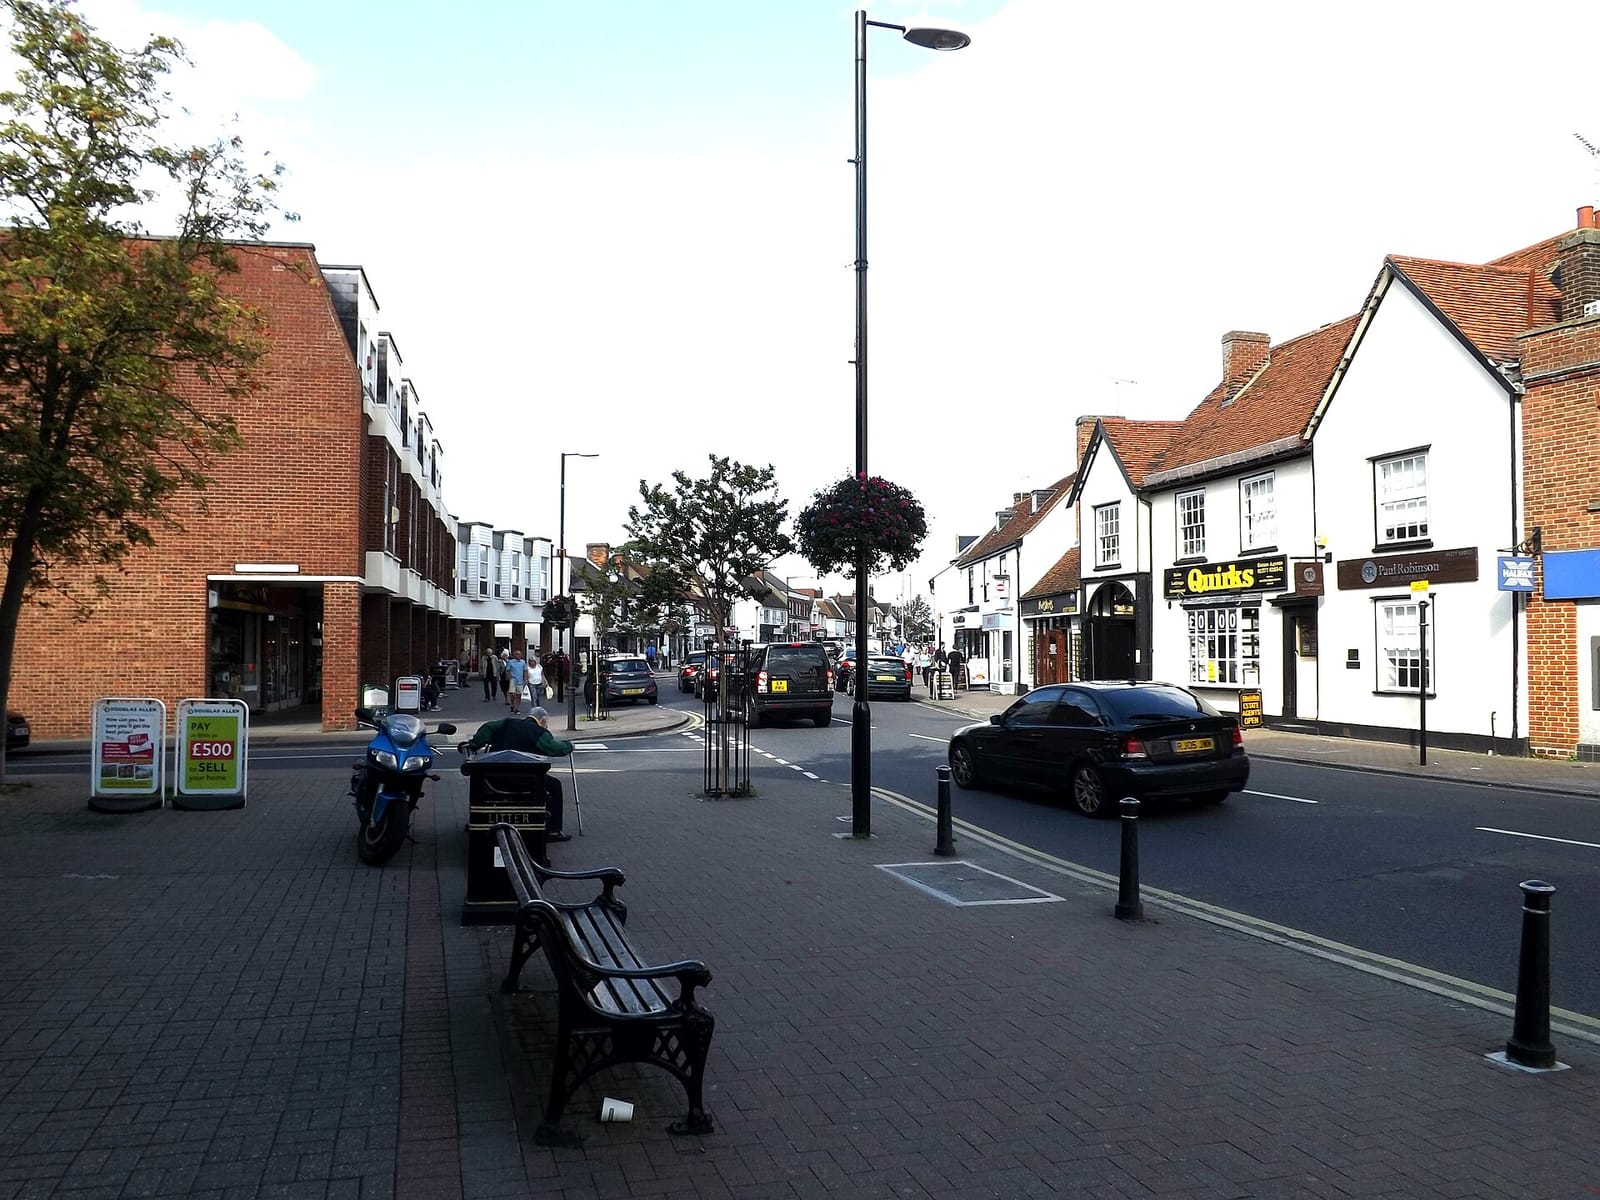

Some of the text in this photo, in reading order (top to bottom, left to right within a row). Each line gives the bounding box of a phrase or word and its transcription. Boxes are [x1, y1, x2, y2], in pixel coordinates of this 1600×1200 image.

[1378, 561, 1440, 576] Paul Robinson
[1503, 568, 1533, 578] HALIFAX
[1187, 564, 1255, 593] Quirks
[1243, 717, 1259, 725] OPEN
[191, 722, 211, 731] PAY
[191, 742, 232, 757] £500
[198, 762, 228, 772] SELL
[189, 775, 205, 783] your
[488, 813, 529, 823] LITTER
